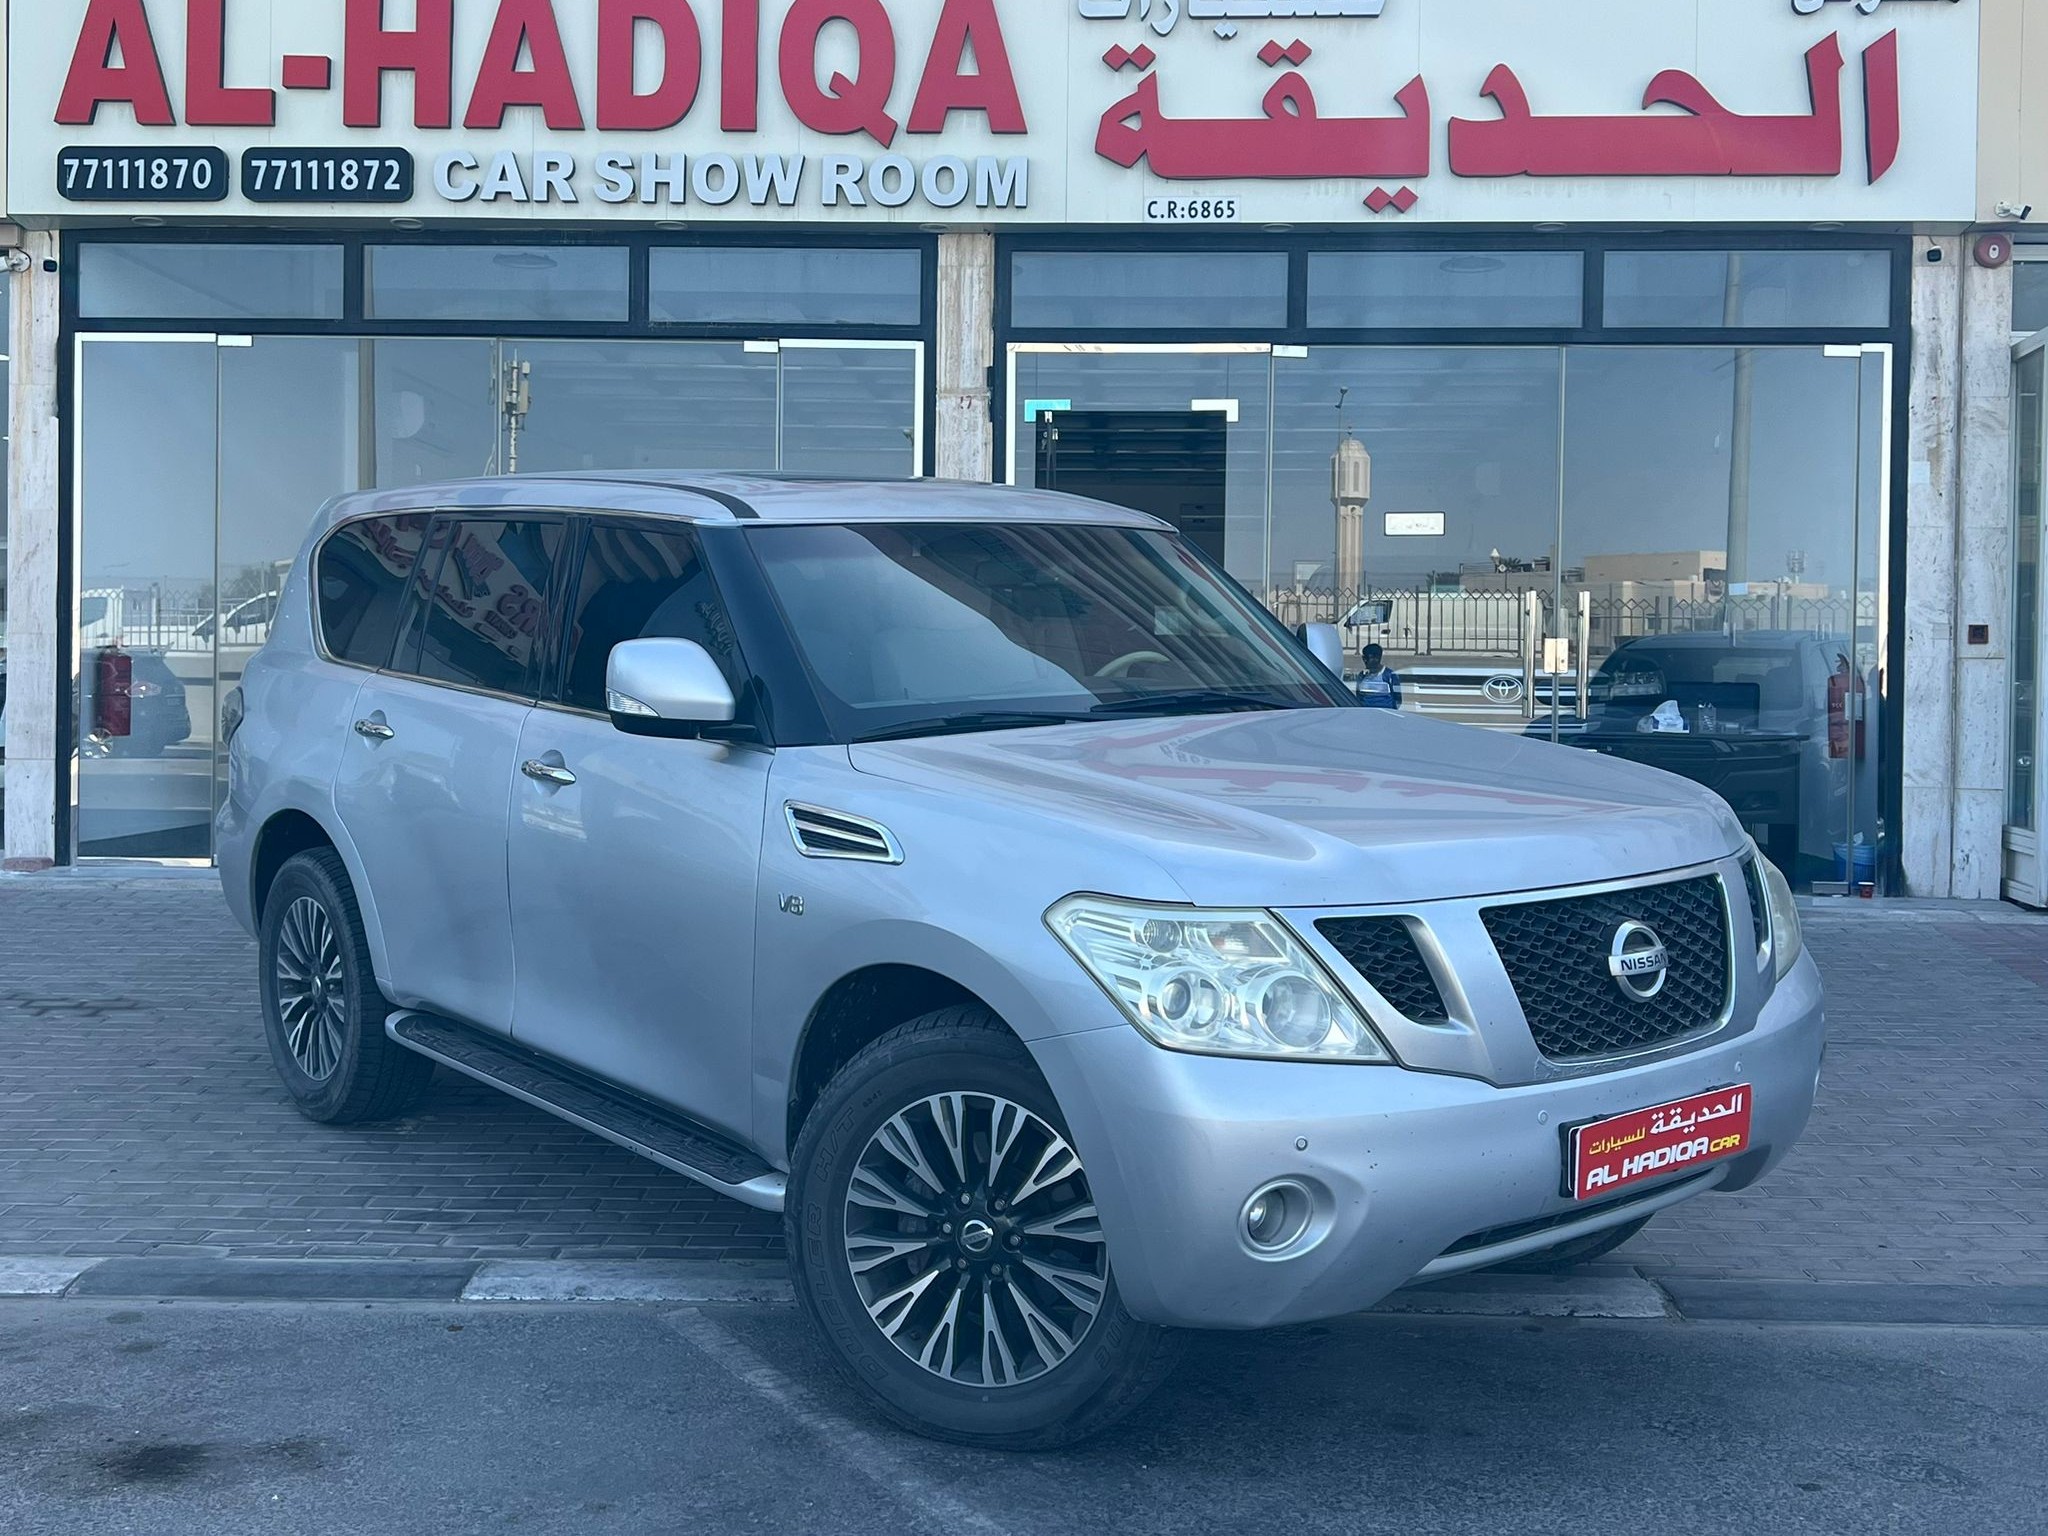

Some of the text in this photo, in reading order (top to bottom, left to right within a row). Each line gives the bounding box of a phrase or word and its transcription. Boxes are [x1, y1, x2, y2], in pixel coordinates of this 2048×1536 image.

[55, 0, 1028, 148] AL-HADIQA
[1095, 28, 1899, 213] الحديقة
[63, 157, 213, 190] 77111870
[250, 158, 401, 191] 77111872
[433, 150, 1029, 209] CAR SHOW ROOM
[1147, 200, 1236, 219] C.R:6865
[778, 892, 804, 916] V8
[1620, 952, 1667, 972] NISSAN
[1588, 1093, 1743, 1155] الحديقة للسيارات
[1586, 1133, 1740, 1190] AL HADIQA CAR
[804, 1201, 888, 1381] DUELER
